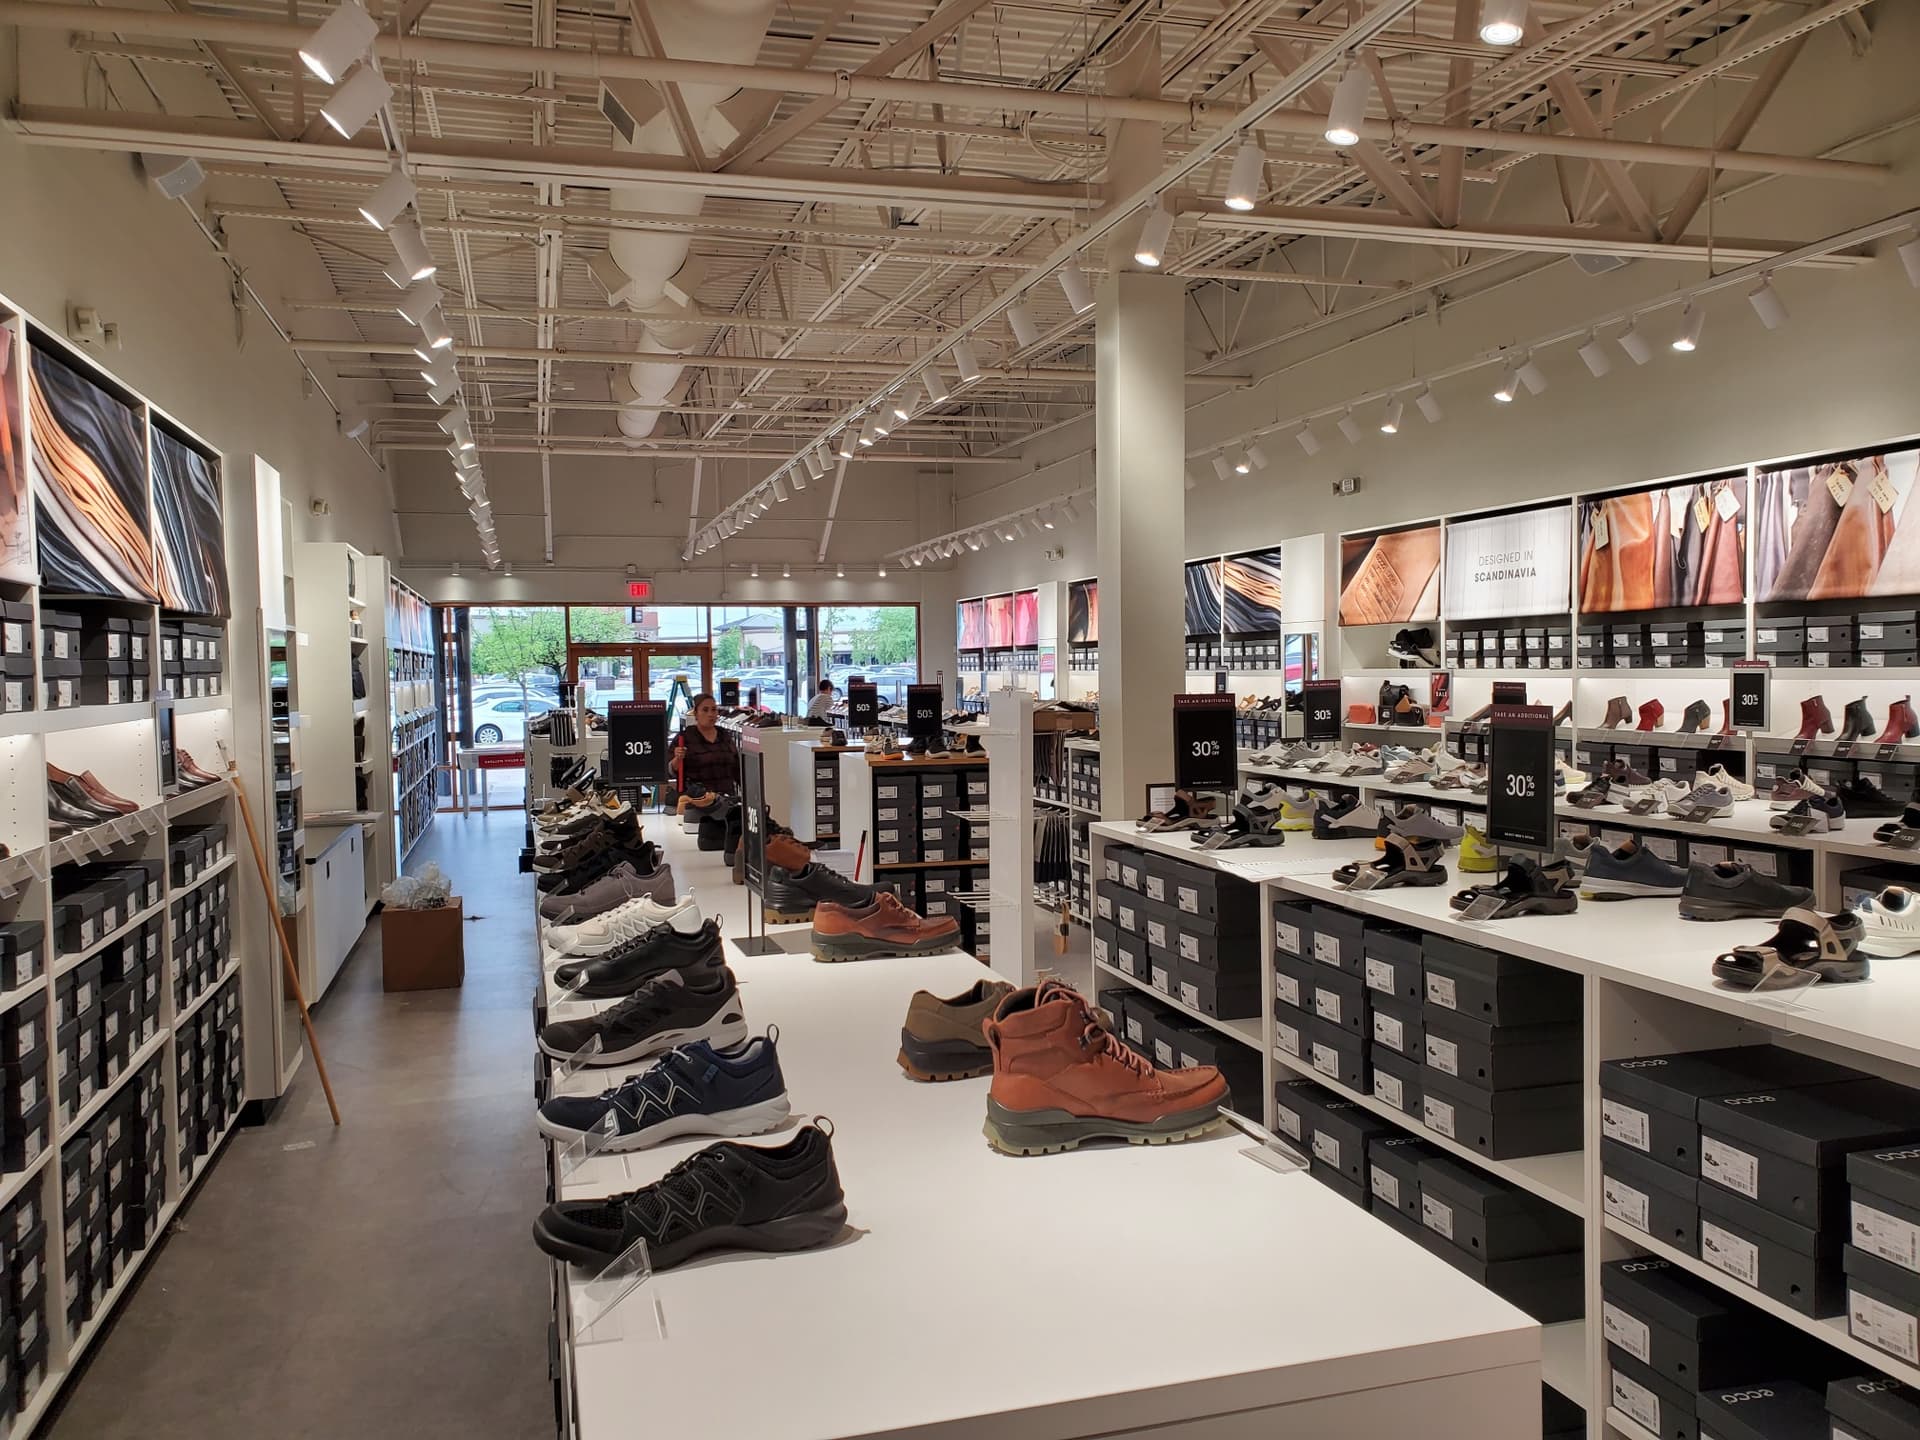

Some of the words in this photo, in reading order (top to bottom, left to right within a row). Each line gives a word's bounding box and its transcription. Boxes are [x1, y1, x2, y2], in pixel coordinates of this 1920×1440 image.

[1479, 551, 1521, 567] DESIGNED
[1524, 550, 1533, 561] IN
[1474, 567, 1536, 583] SCANDINAVIA
[625, 741, 652, 756] 30%
[1192, 741, 1220, 757] 30%
[1506, 774, 1535, 797] 30%
